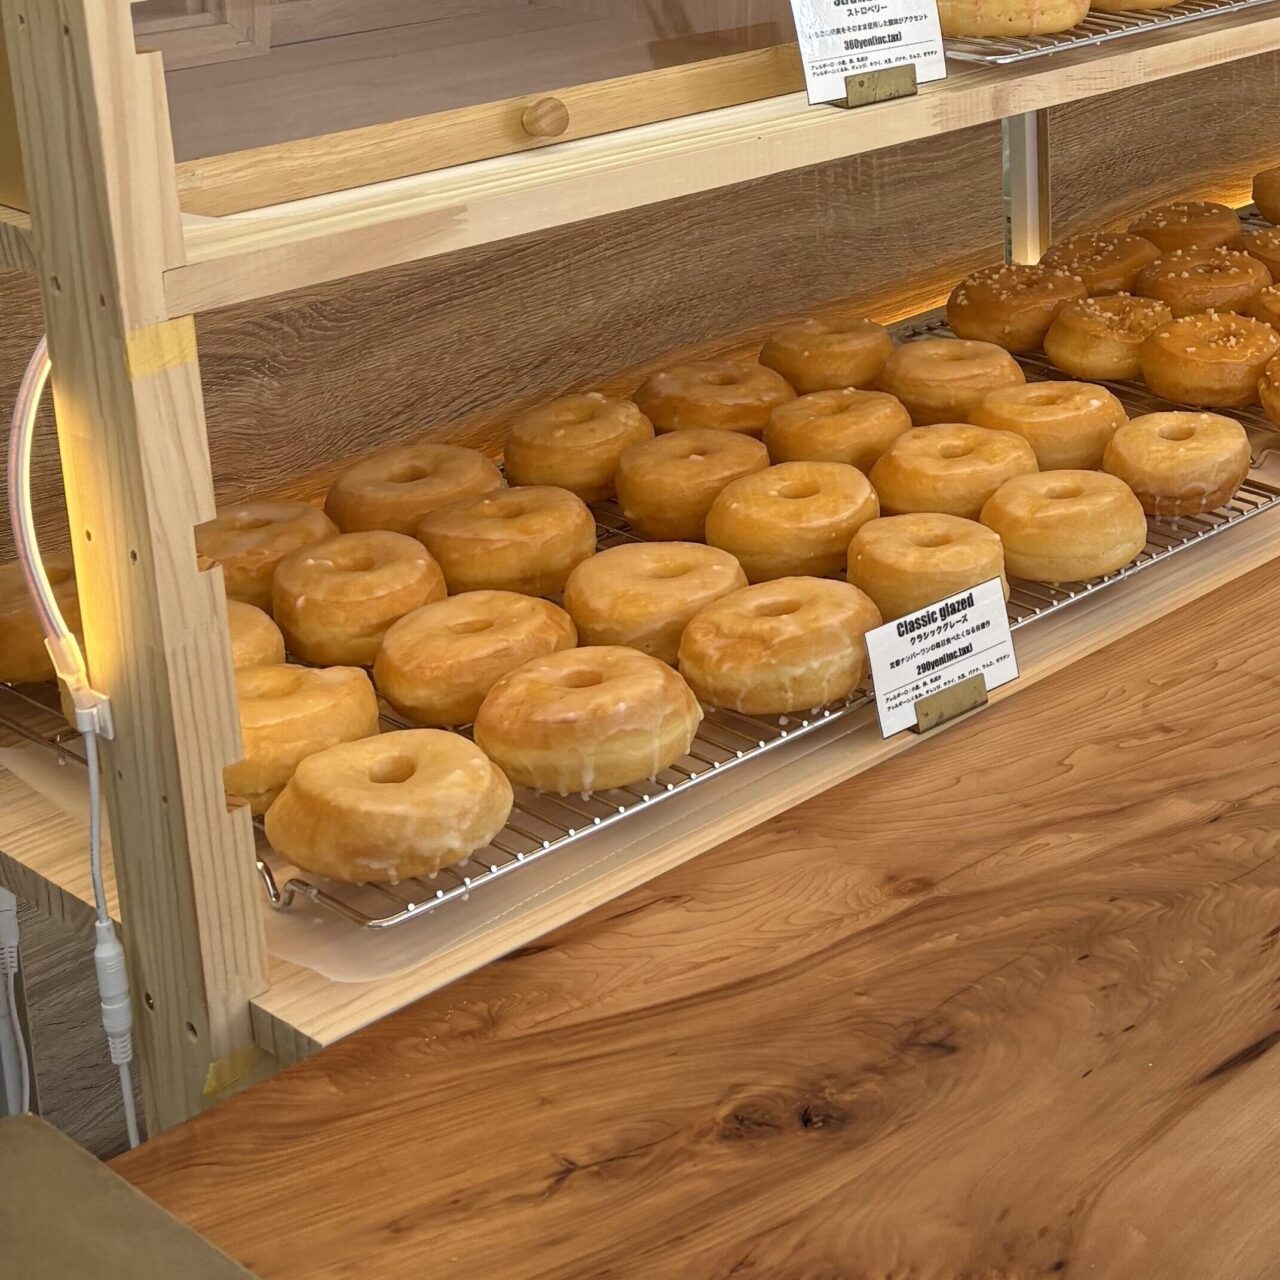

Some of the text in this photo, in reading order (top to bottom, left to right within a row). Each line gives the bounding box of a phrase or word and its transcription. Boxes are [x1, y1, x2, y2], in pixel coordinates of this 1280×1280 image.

[846, 4, 888, 17] ストロベリー
[896, 592, 975, 637] Classic glazed
[910, 613, 969, 646] クラシックグレーズ
[916, 642, 974, 676] 290yen(inc.tax)
